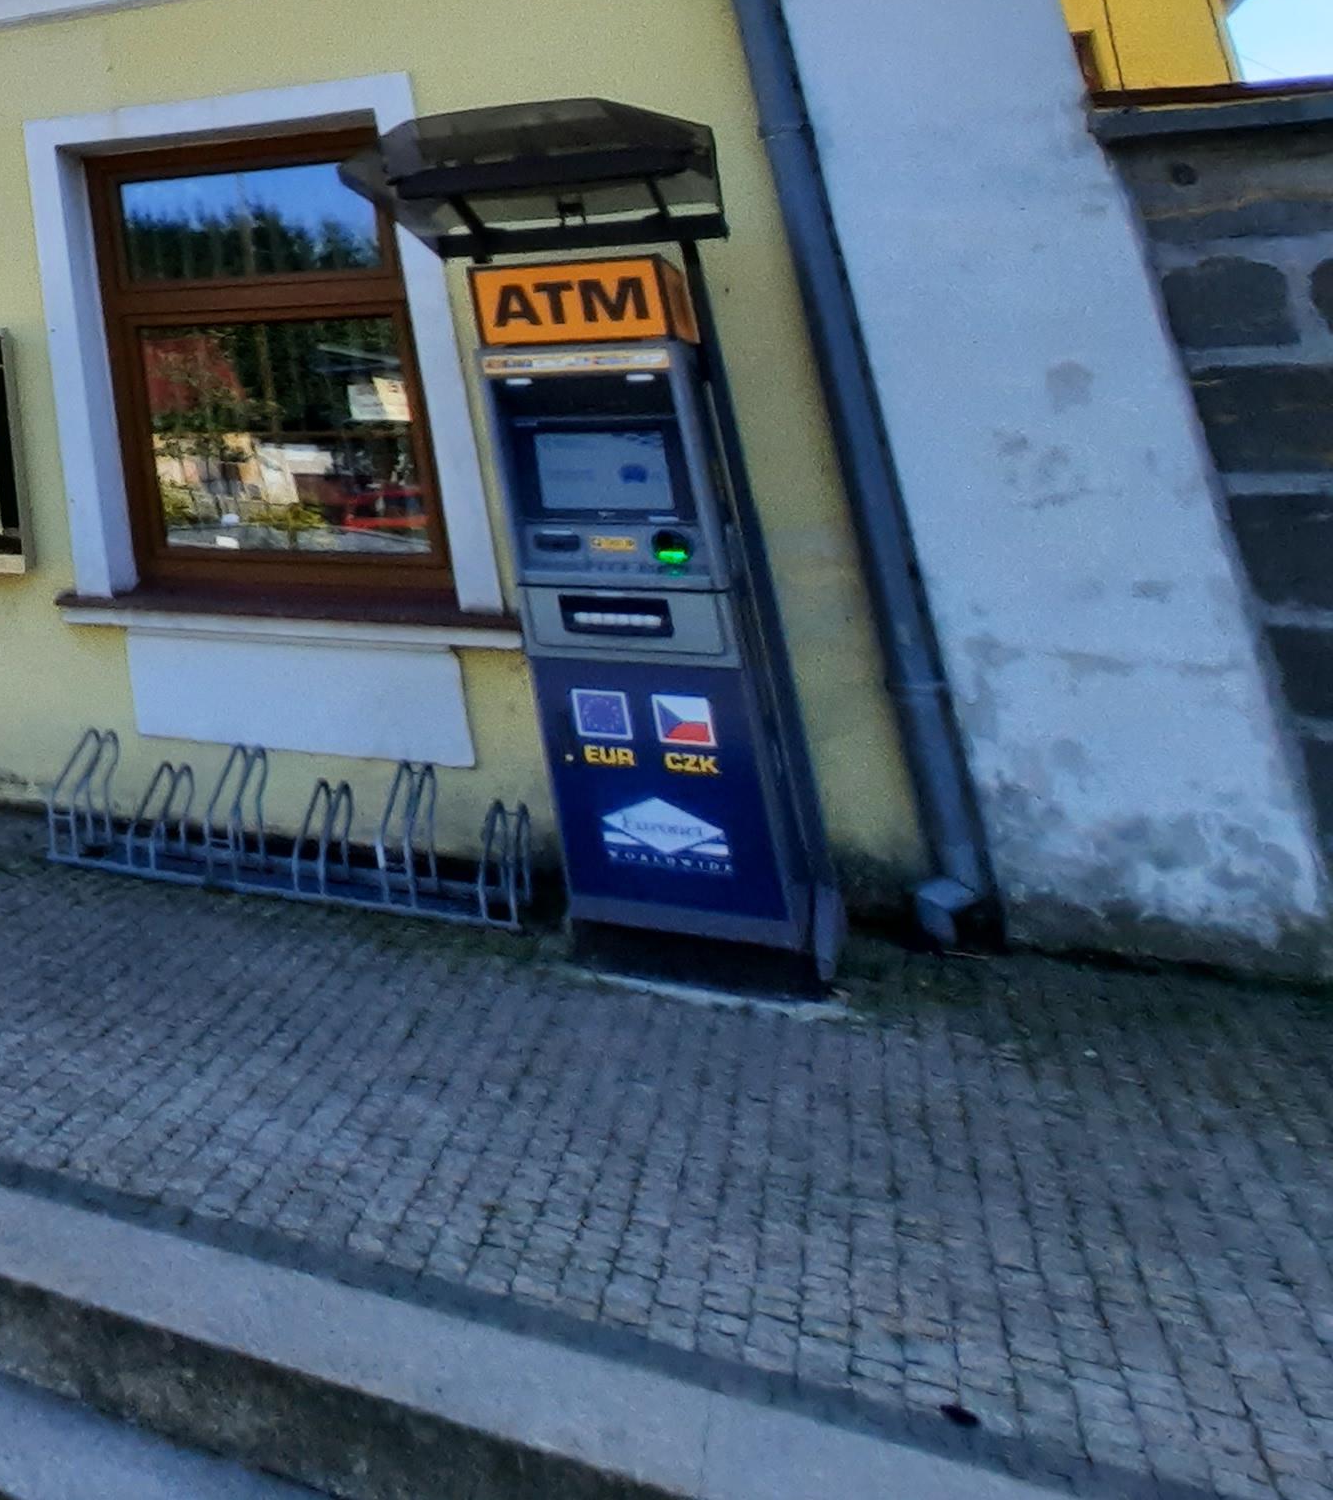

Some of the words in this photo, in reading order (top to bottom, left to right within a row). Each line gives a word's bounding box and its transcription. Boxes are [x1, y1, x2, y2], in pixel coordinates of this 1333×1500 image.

[493, 277, 650, 327] ATM
[584, 744, 636, 767] EUR
[664, 752, 721, 775] CZK
